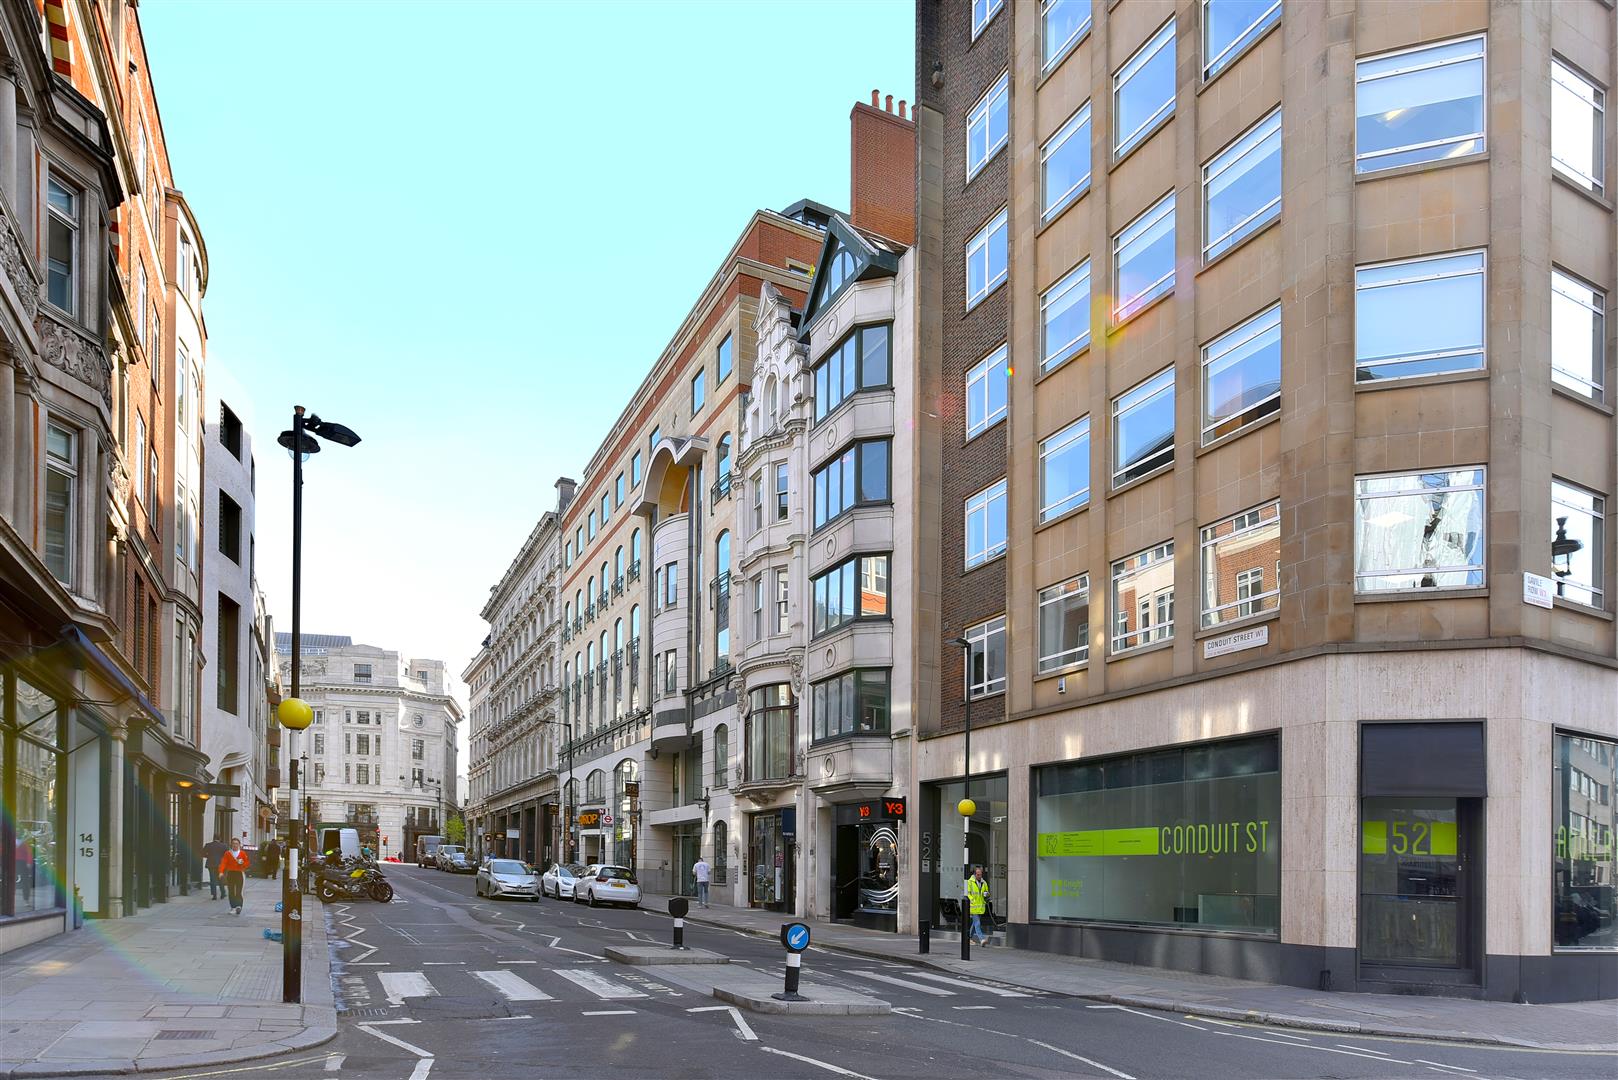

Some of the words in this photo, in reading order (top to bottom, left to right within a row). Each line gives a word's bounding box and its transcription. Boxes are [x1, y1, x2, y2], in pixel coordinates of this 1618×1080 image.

[1207, 637, 1232, 650] CONDUIT
[1233, 631, 1254, 643] STREET
[79, 833, 94, 843] 14
[1161, 822, 1240, 855] CONDUIT
[1245, 820, 1269, 854] ST
[1392, 821, 1429, 855] 52
[79, 847, 94, 858] 15
